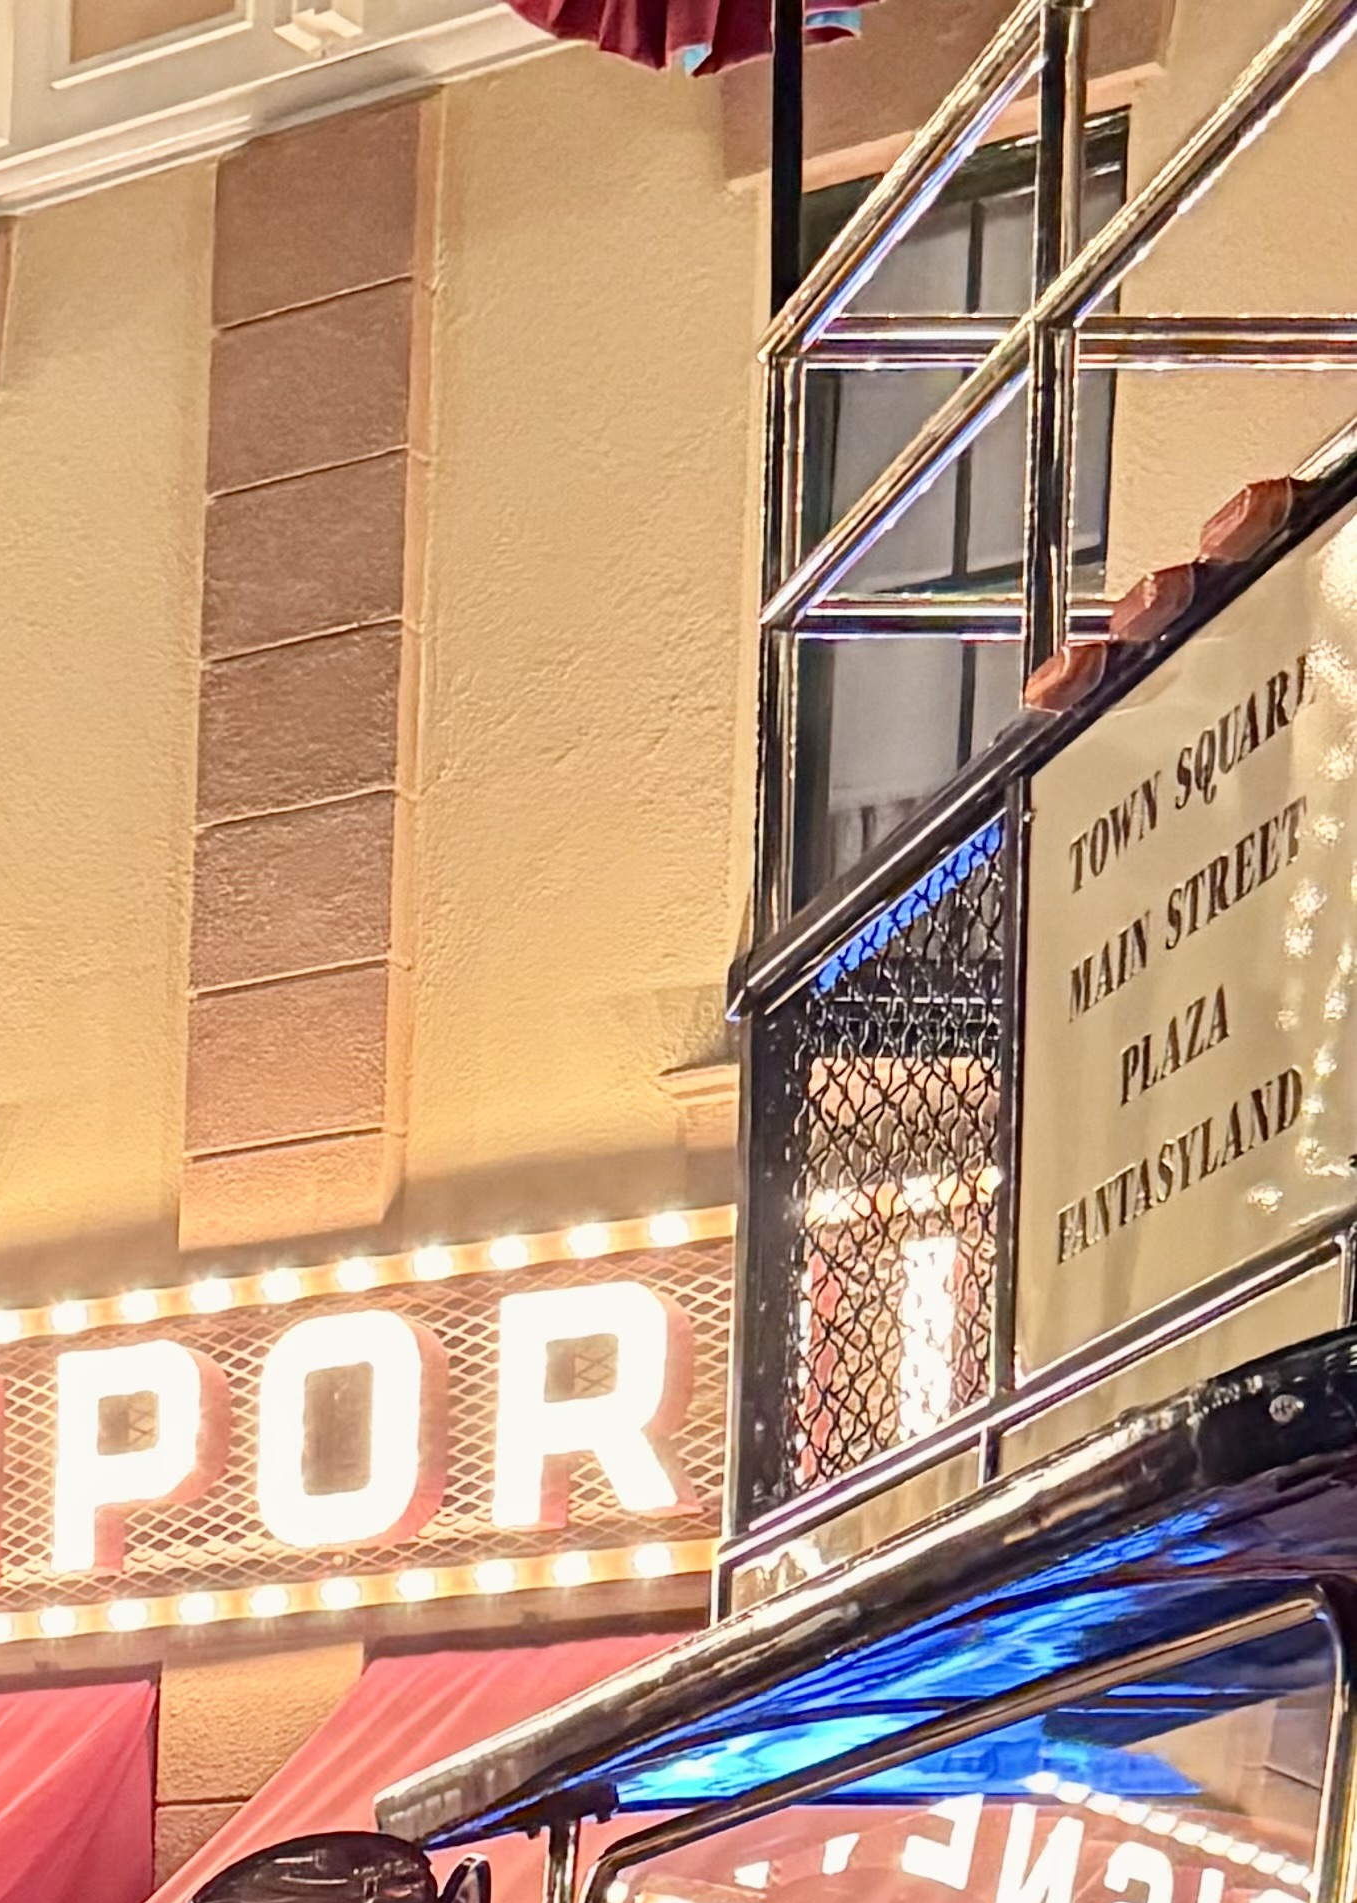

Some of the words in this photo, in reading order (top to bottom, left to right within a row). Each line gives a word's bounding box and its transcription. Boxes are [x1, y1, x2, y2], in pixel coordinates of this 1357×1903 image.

[1068, 908, 1150, 1023] MAIN
[1165, 794, 1307, 951] STREET
[1069, 770, 1162, 893] TOWN
[1120, 983, 1230, 1107] PLAZA
[1057, 1066, 1303, 1264] FANTASYLAND
